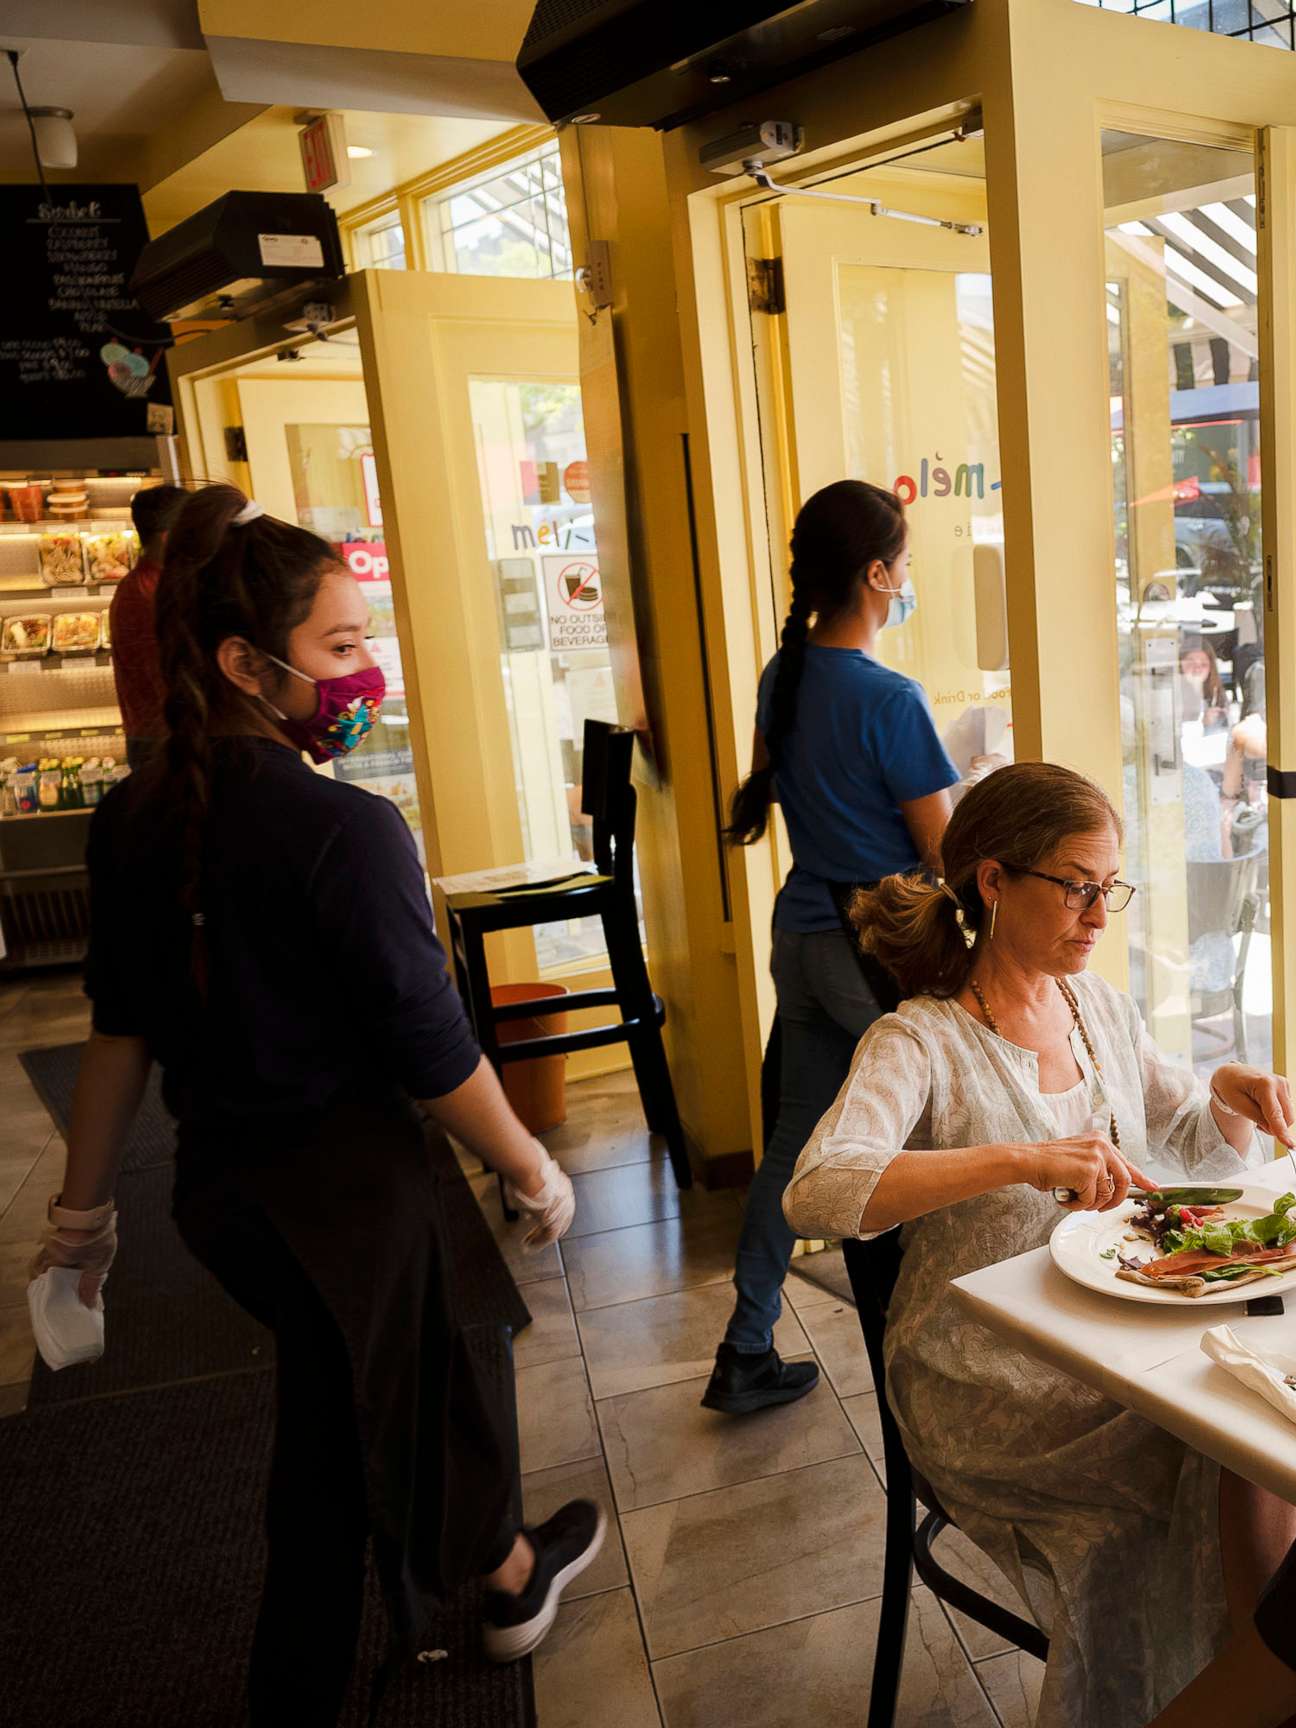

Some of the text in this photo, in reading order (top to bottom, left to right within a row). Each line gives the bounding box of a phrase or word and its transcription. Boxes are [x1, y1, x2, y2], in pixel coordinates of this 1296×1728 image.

[551, 614, 606, 625] NO OUTSI
[560, 625, 590, 635] FOOD
[553, 636, 609, 647] BEVERAG
